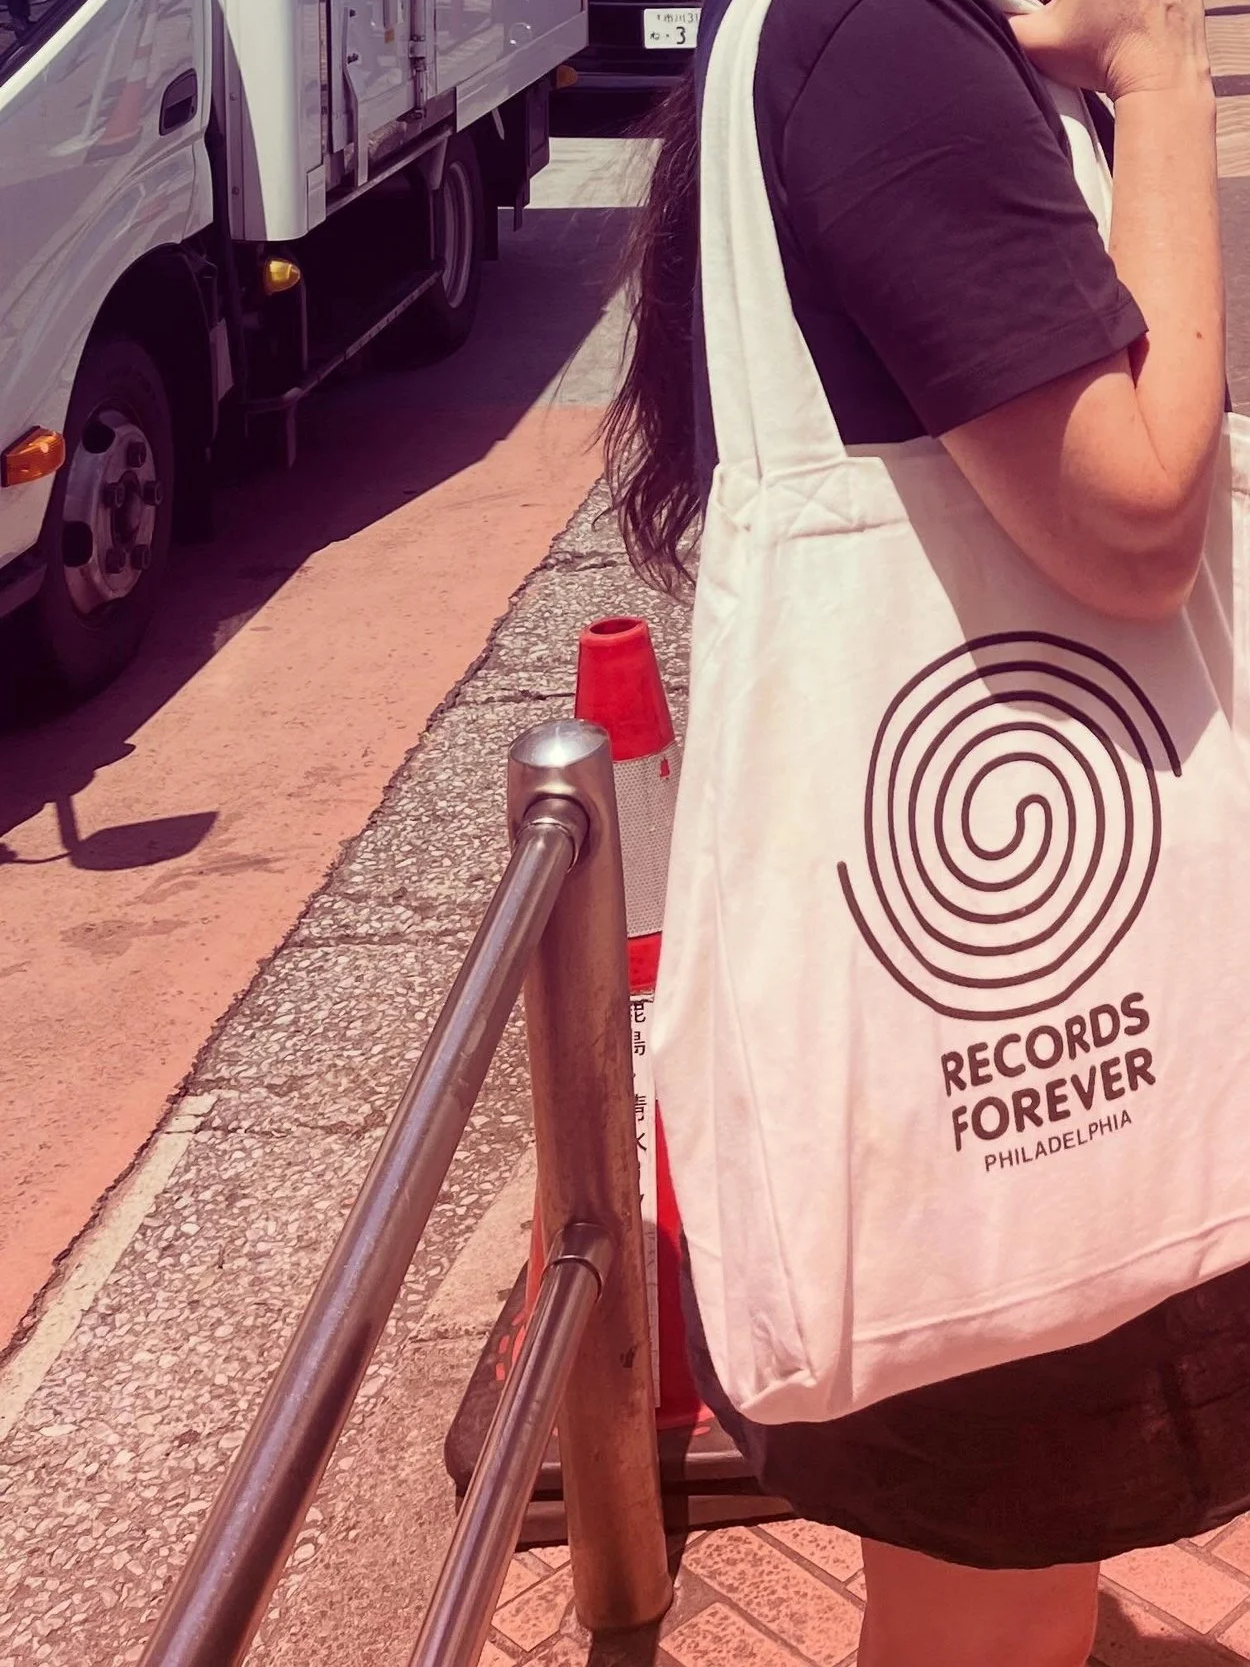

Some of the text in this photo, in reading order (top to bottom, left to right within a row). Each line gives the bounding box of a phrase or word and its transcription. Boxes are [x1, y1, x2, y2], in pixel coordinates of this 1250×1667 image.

[941, 992, 1150, 1097] RECORDS
[952, 1047, 1156, 1152] FOREVER
[984, 1109, 1132, 1172] PHILADELPHIA
